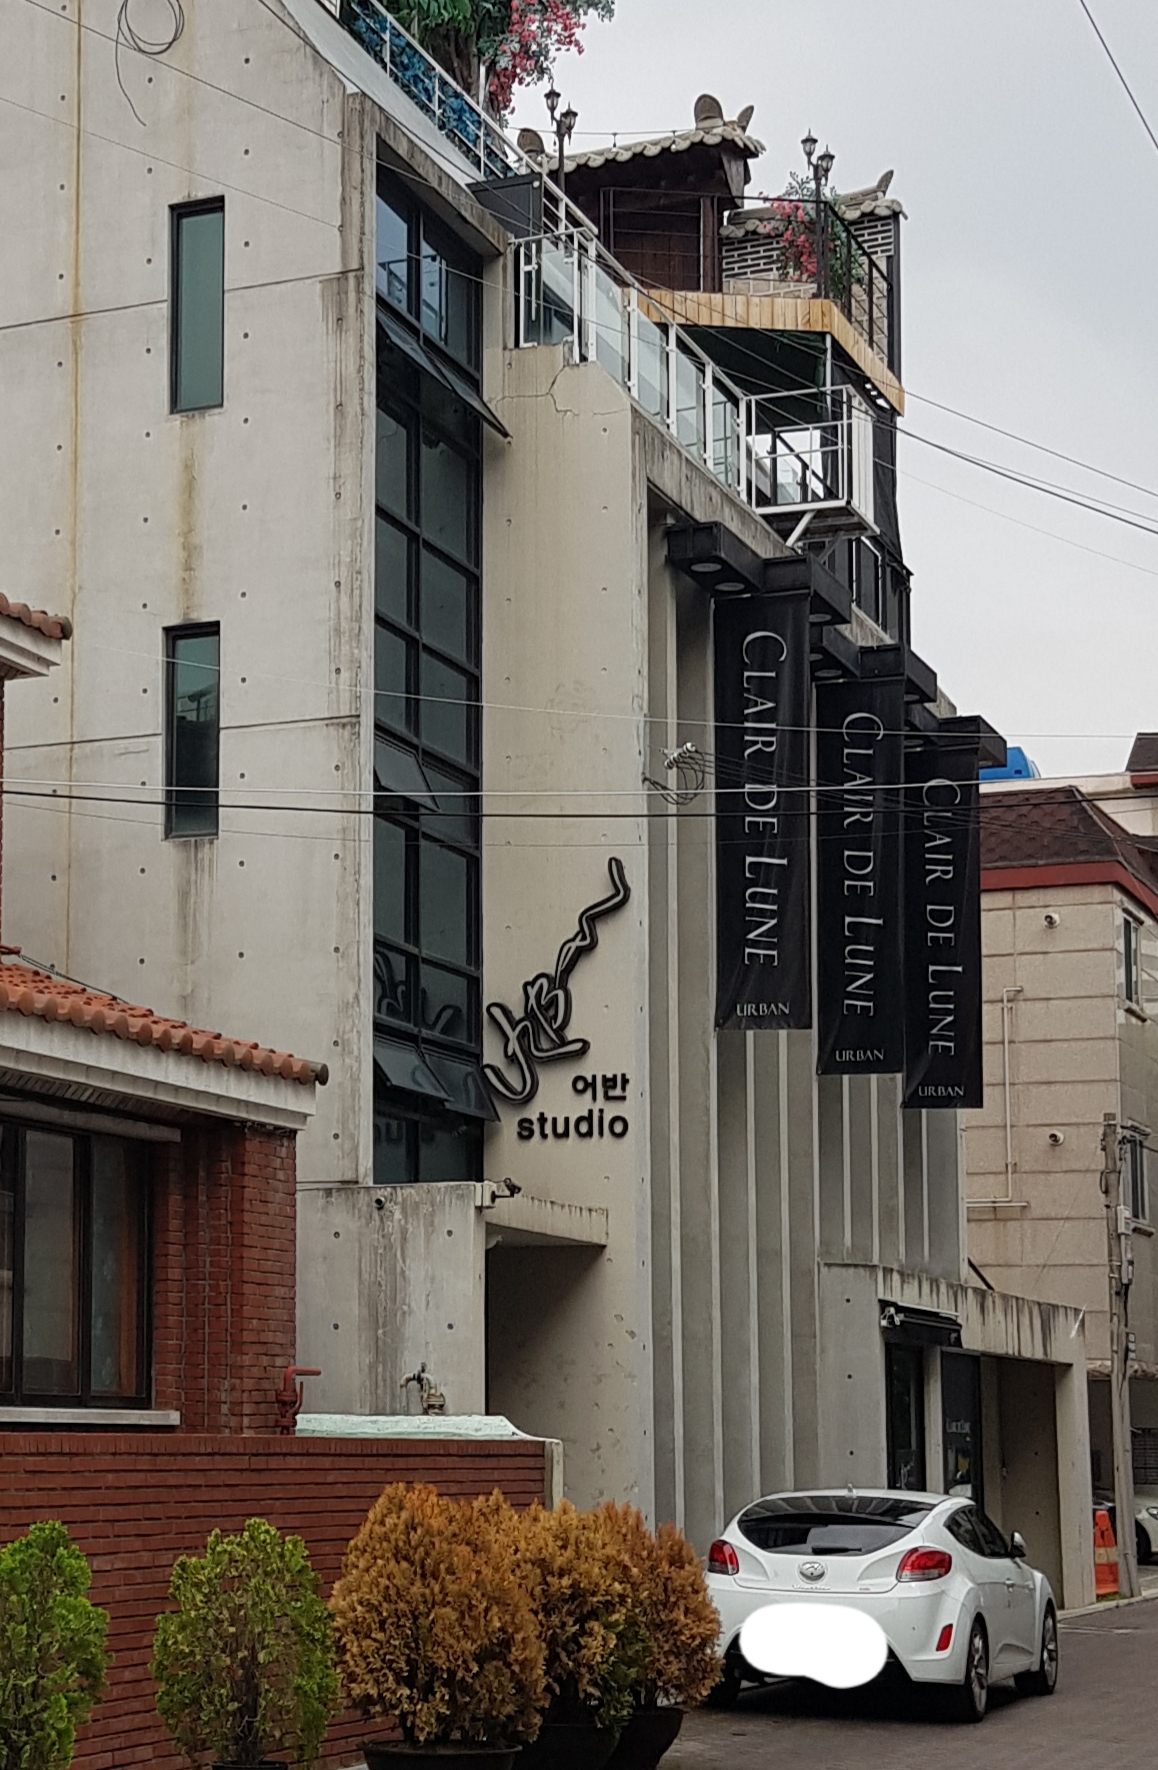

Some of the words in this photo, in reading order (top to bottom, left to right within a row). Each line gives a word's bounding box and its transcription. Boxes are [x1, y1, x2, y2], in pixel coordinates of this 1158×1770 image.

[743, 631, 787, 760] CLAIR
[842, 712, 884, 829] CLAIR
[744, 783, 778, 834] DE
[922, 778, 961, 886] CLAIR
[843, 849, 874, 896] DE
[744, 855, 788, 967] LUNE
[926, 904, 955, 947] DE
[843, 914, 884, 1017] LUNE
[736, 1002, 791, 1018] URBAN
[927, 964, 963, 1056] LUNE
[835, 1049, 885, 1063] URBAN
[571, 1073, 630, 1102] 어반
[918, 1085, 965, 1097] URBAN
[516, 1108, 630, 1140] studio
